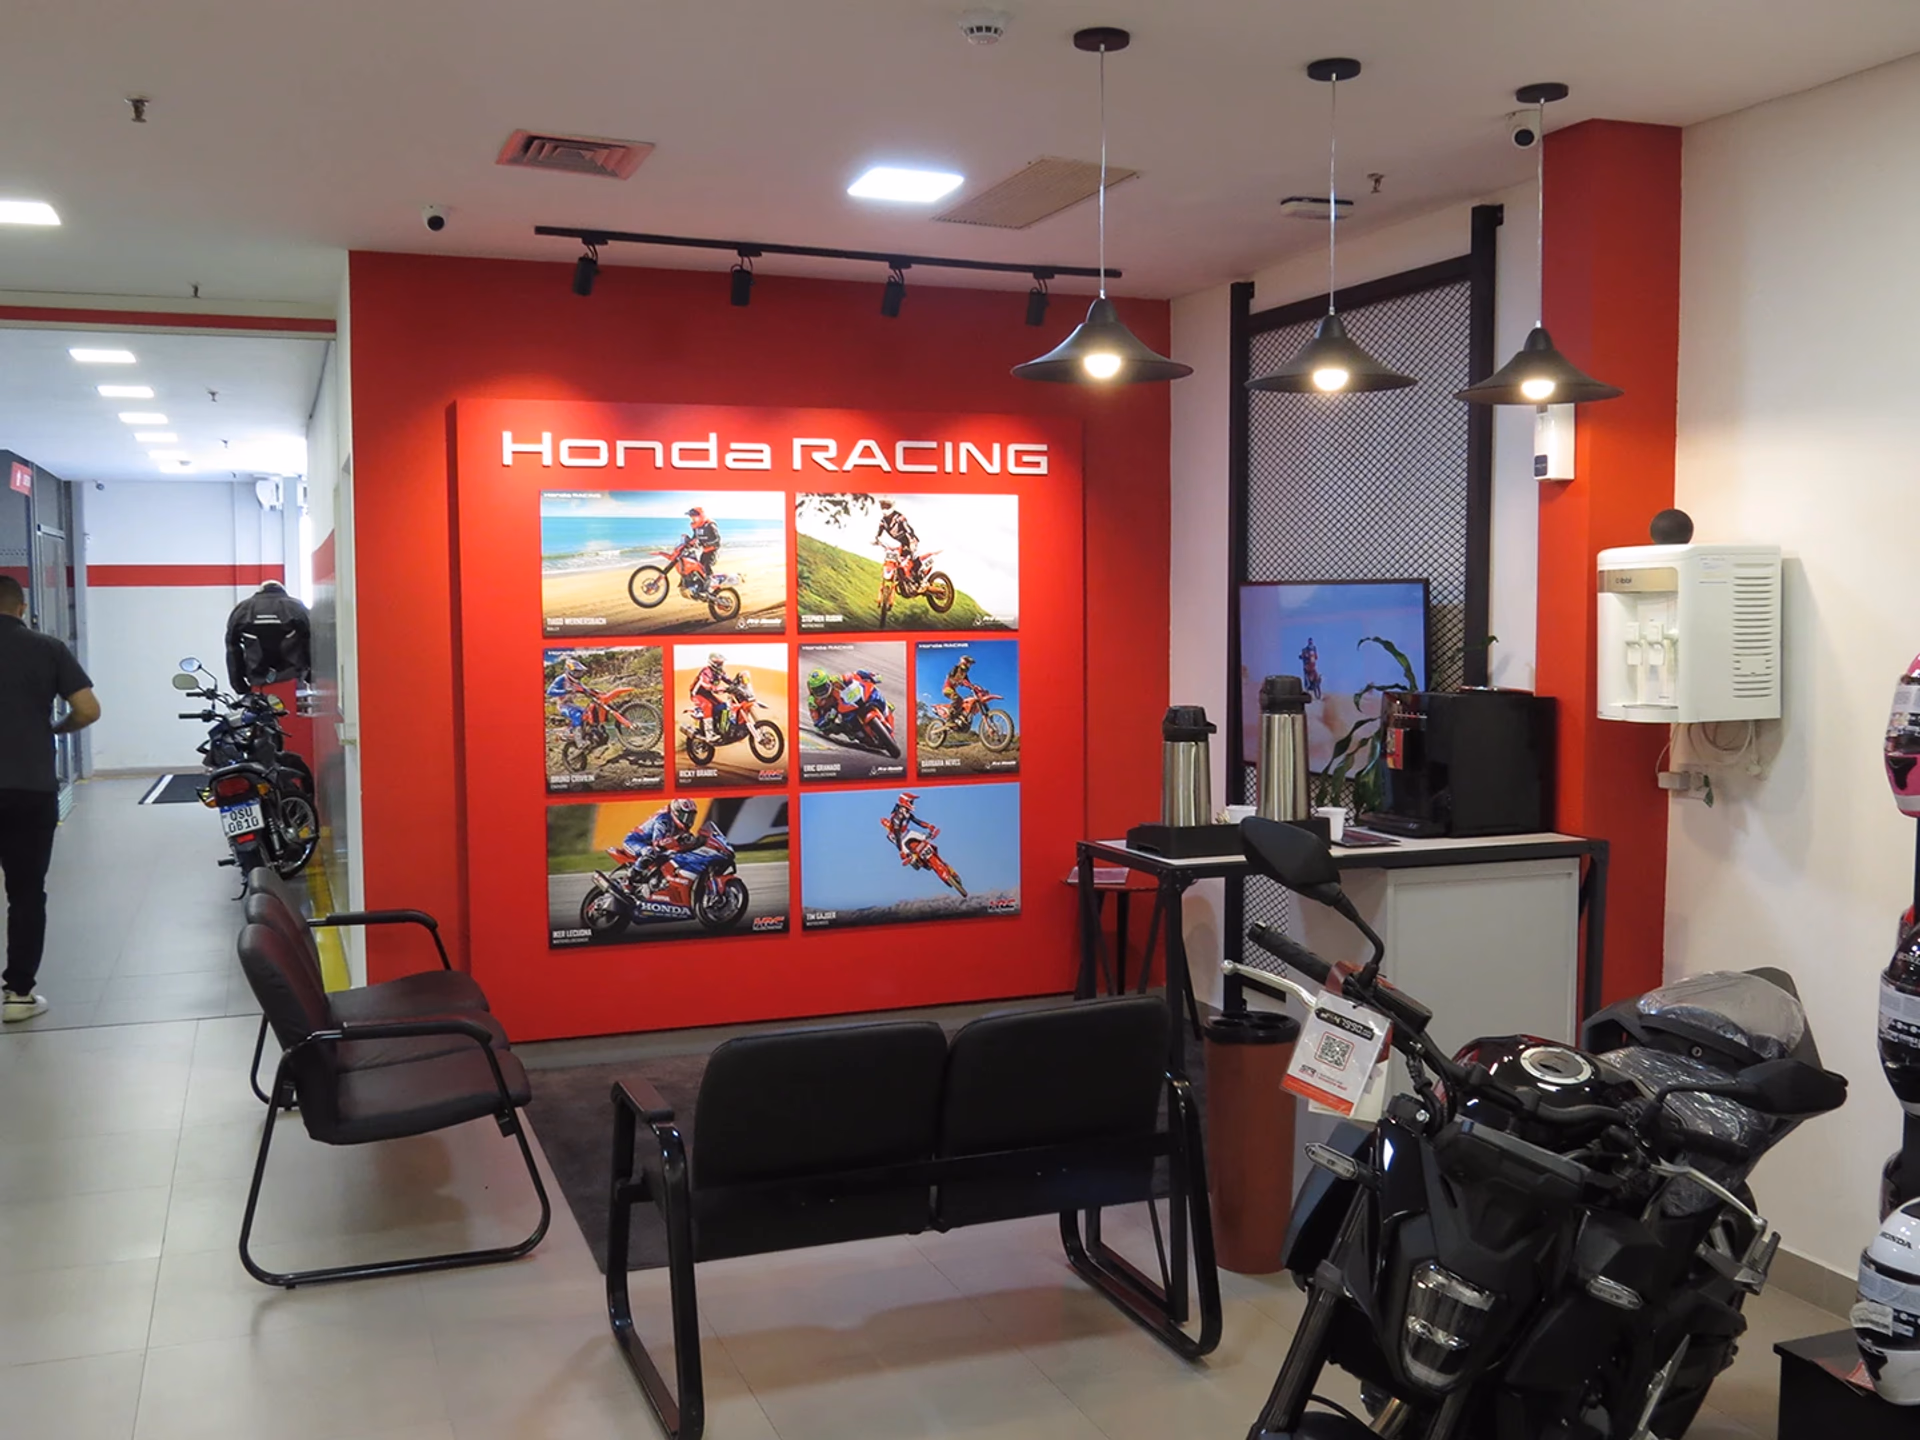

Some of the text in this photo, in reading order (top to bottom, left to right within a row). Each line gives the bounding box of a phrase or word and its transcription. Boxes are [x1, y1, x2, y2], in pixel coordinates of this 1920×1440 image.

[502, 430, 1049, 475] Honda RACING
[641, 902, 692, 916] HONDA
